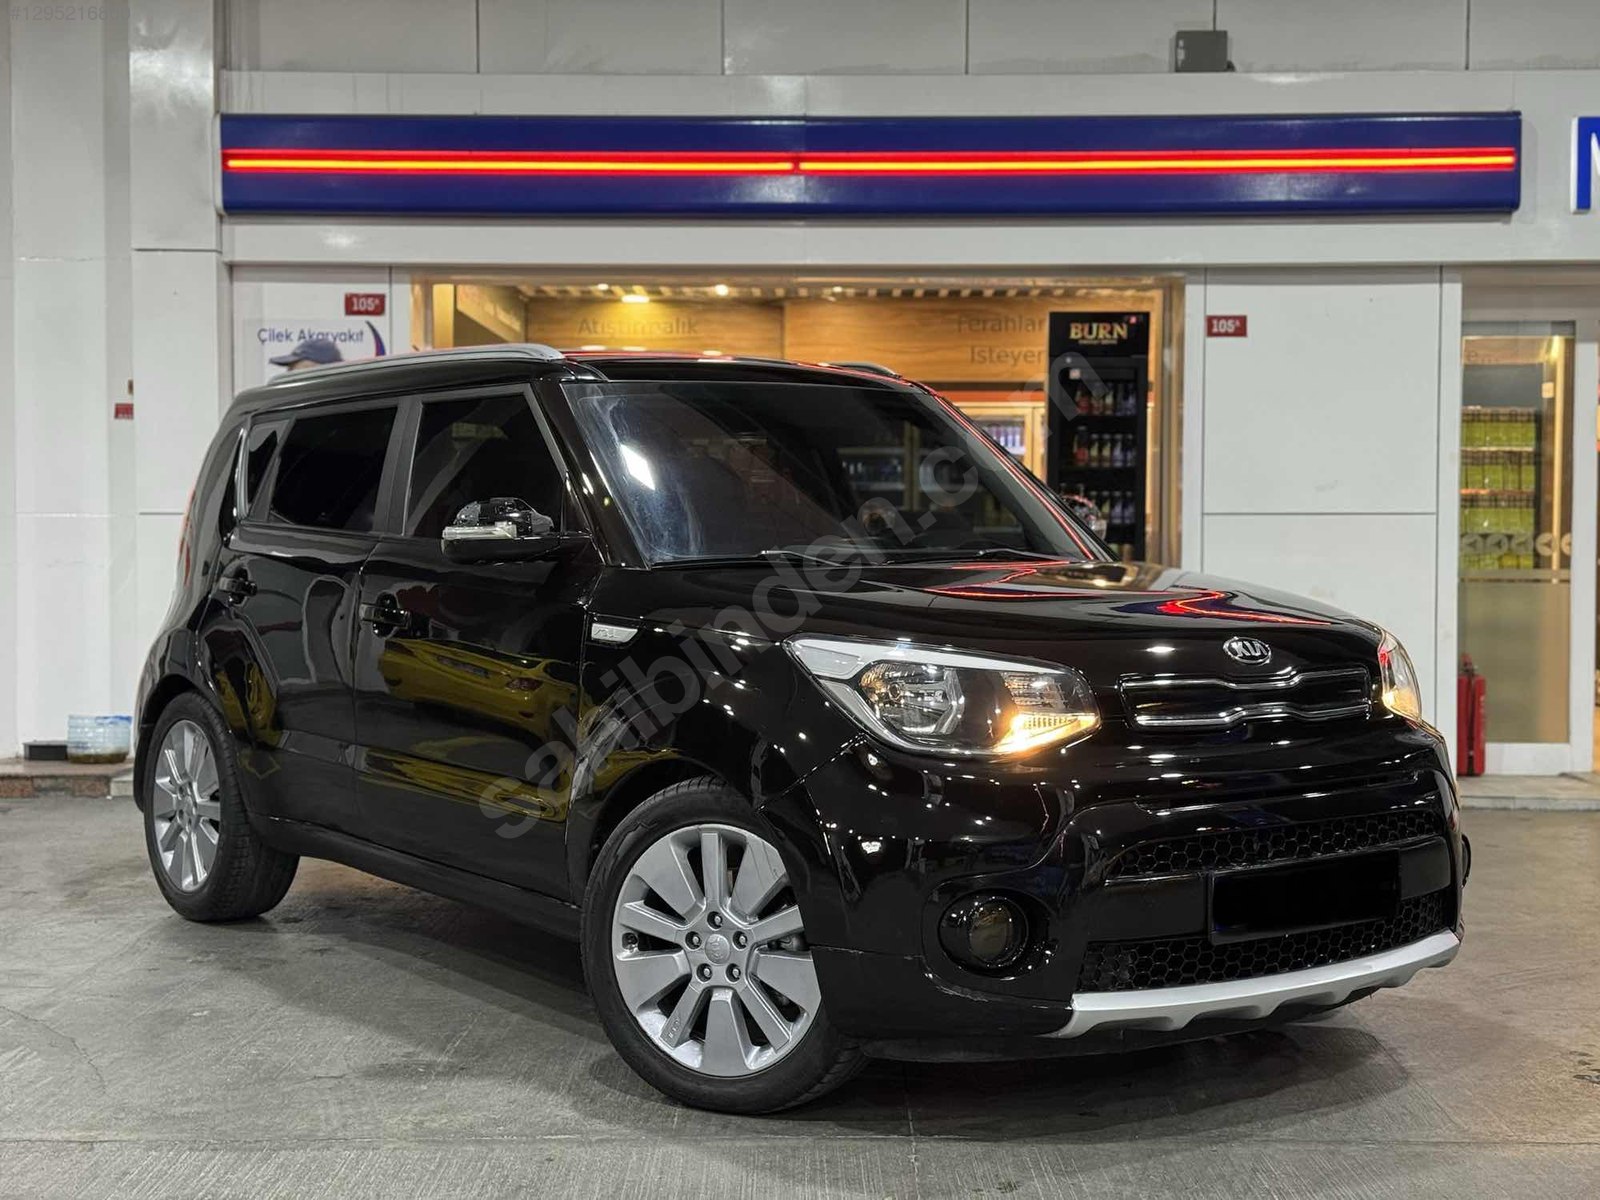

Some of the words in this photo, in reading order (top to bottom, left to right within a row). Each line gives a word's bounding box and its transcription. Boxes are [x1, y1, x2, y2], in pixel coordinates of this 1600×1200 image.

[257, 327, 293, 345] Çilek
[298, 327, 364, 344] Akaryakıt
[1068, 321, 1128, 340] BURN
[1230, 640, 1268, 657] KIA
